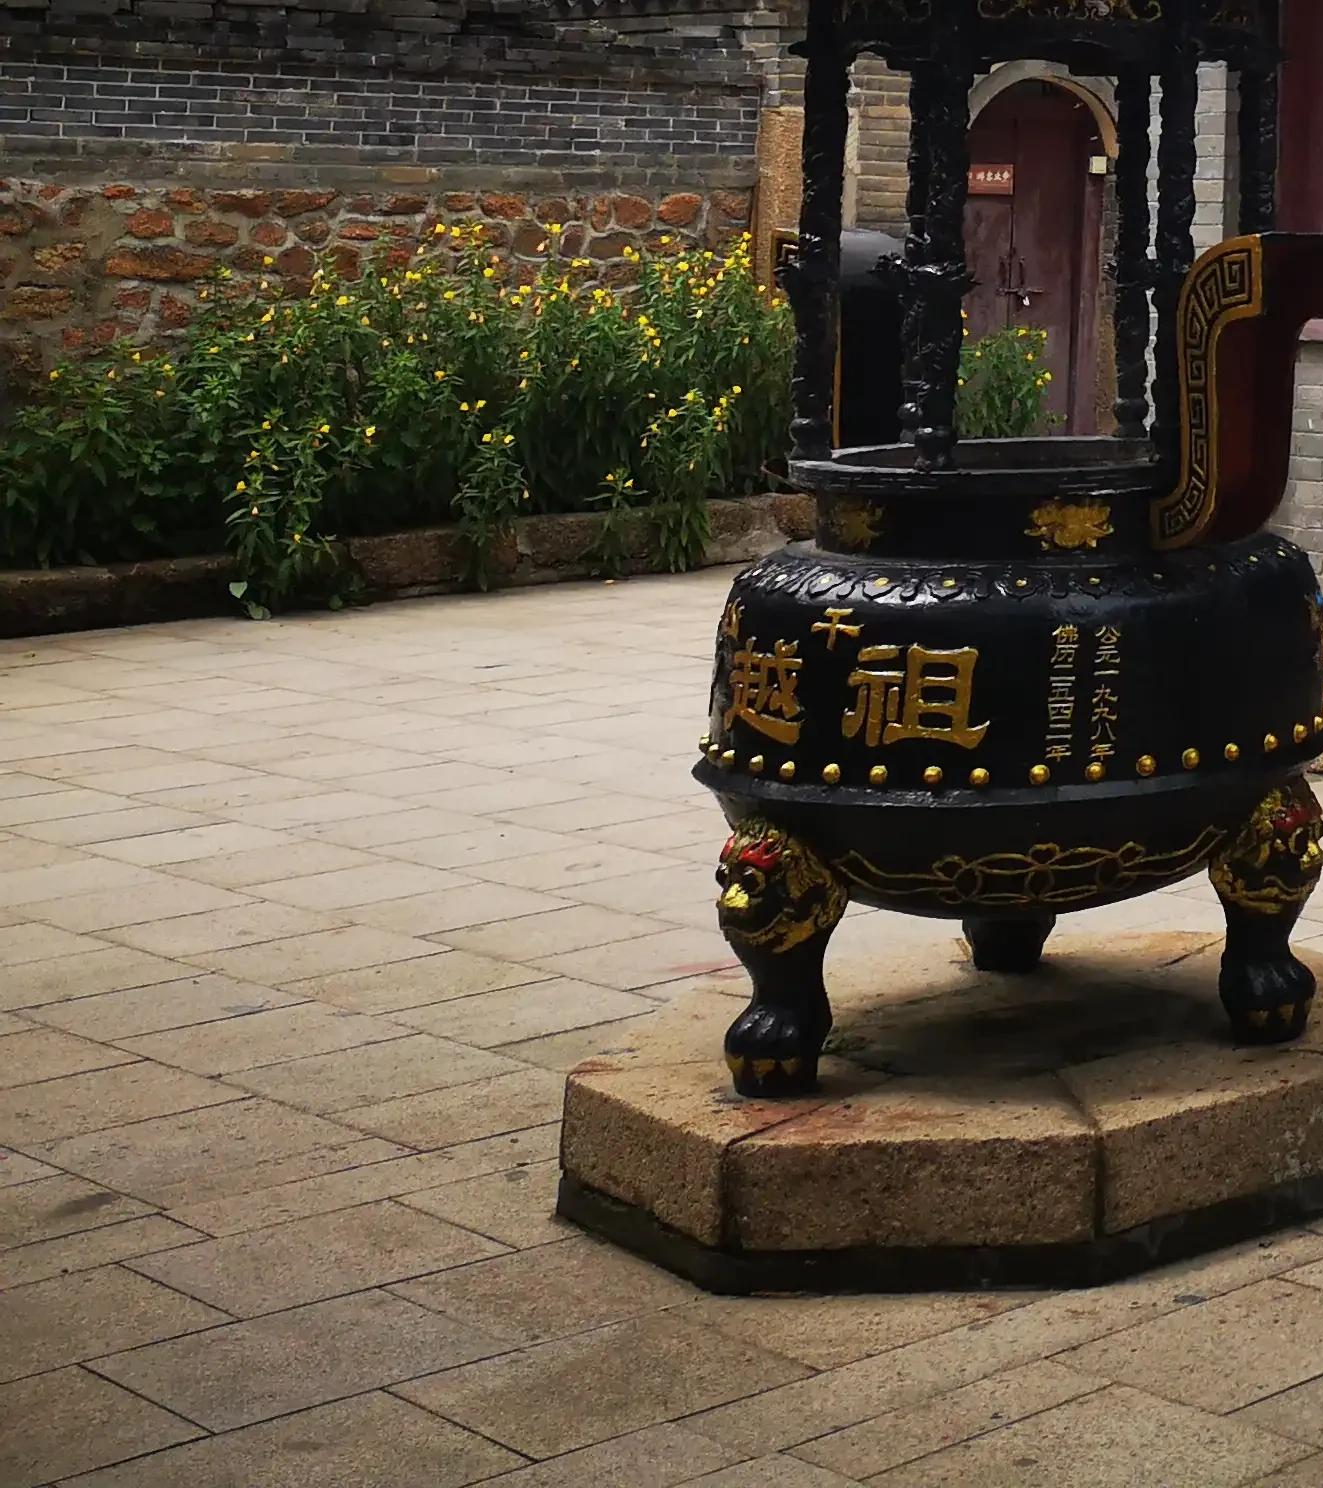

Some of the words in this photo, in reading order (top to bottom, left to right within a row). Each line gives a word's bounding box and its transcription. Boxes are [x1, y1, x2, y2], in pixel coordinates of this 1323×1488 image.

[1044, 623, 1080, 763] 佛历二五四二年
[1090, 624, 1121, 762] 公元一九九八年
